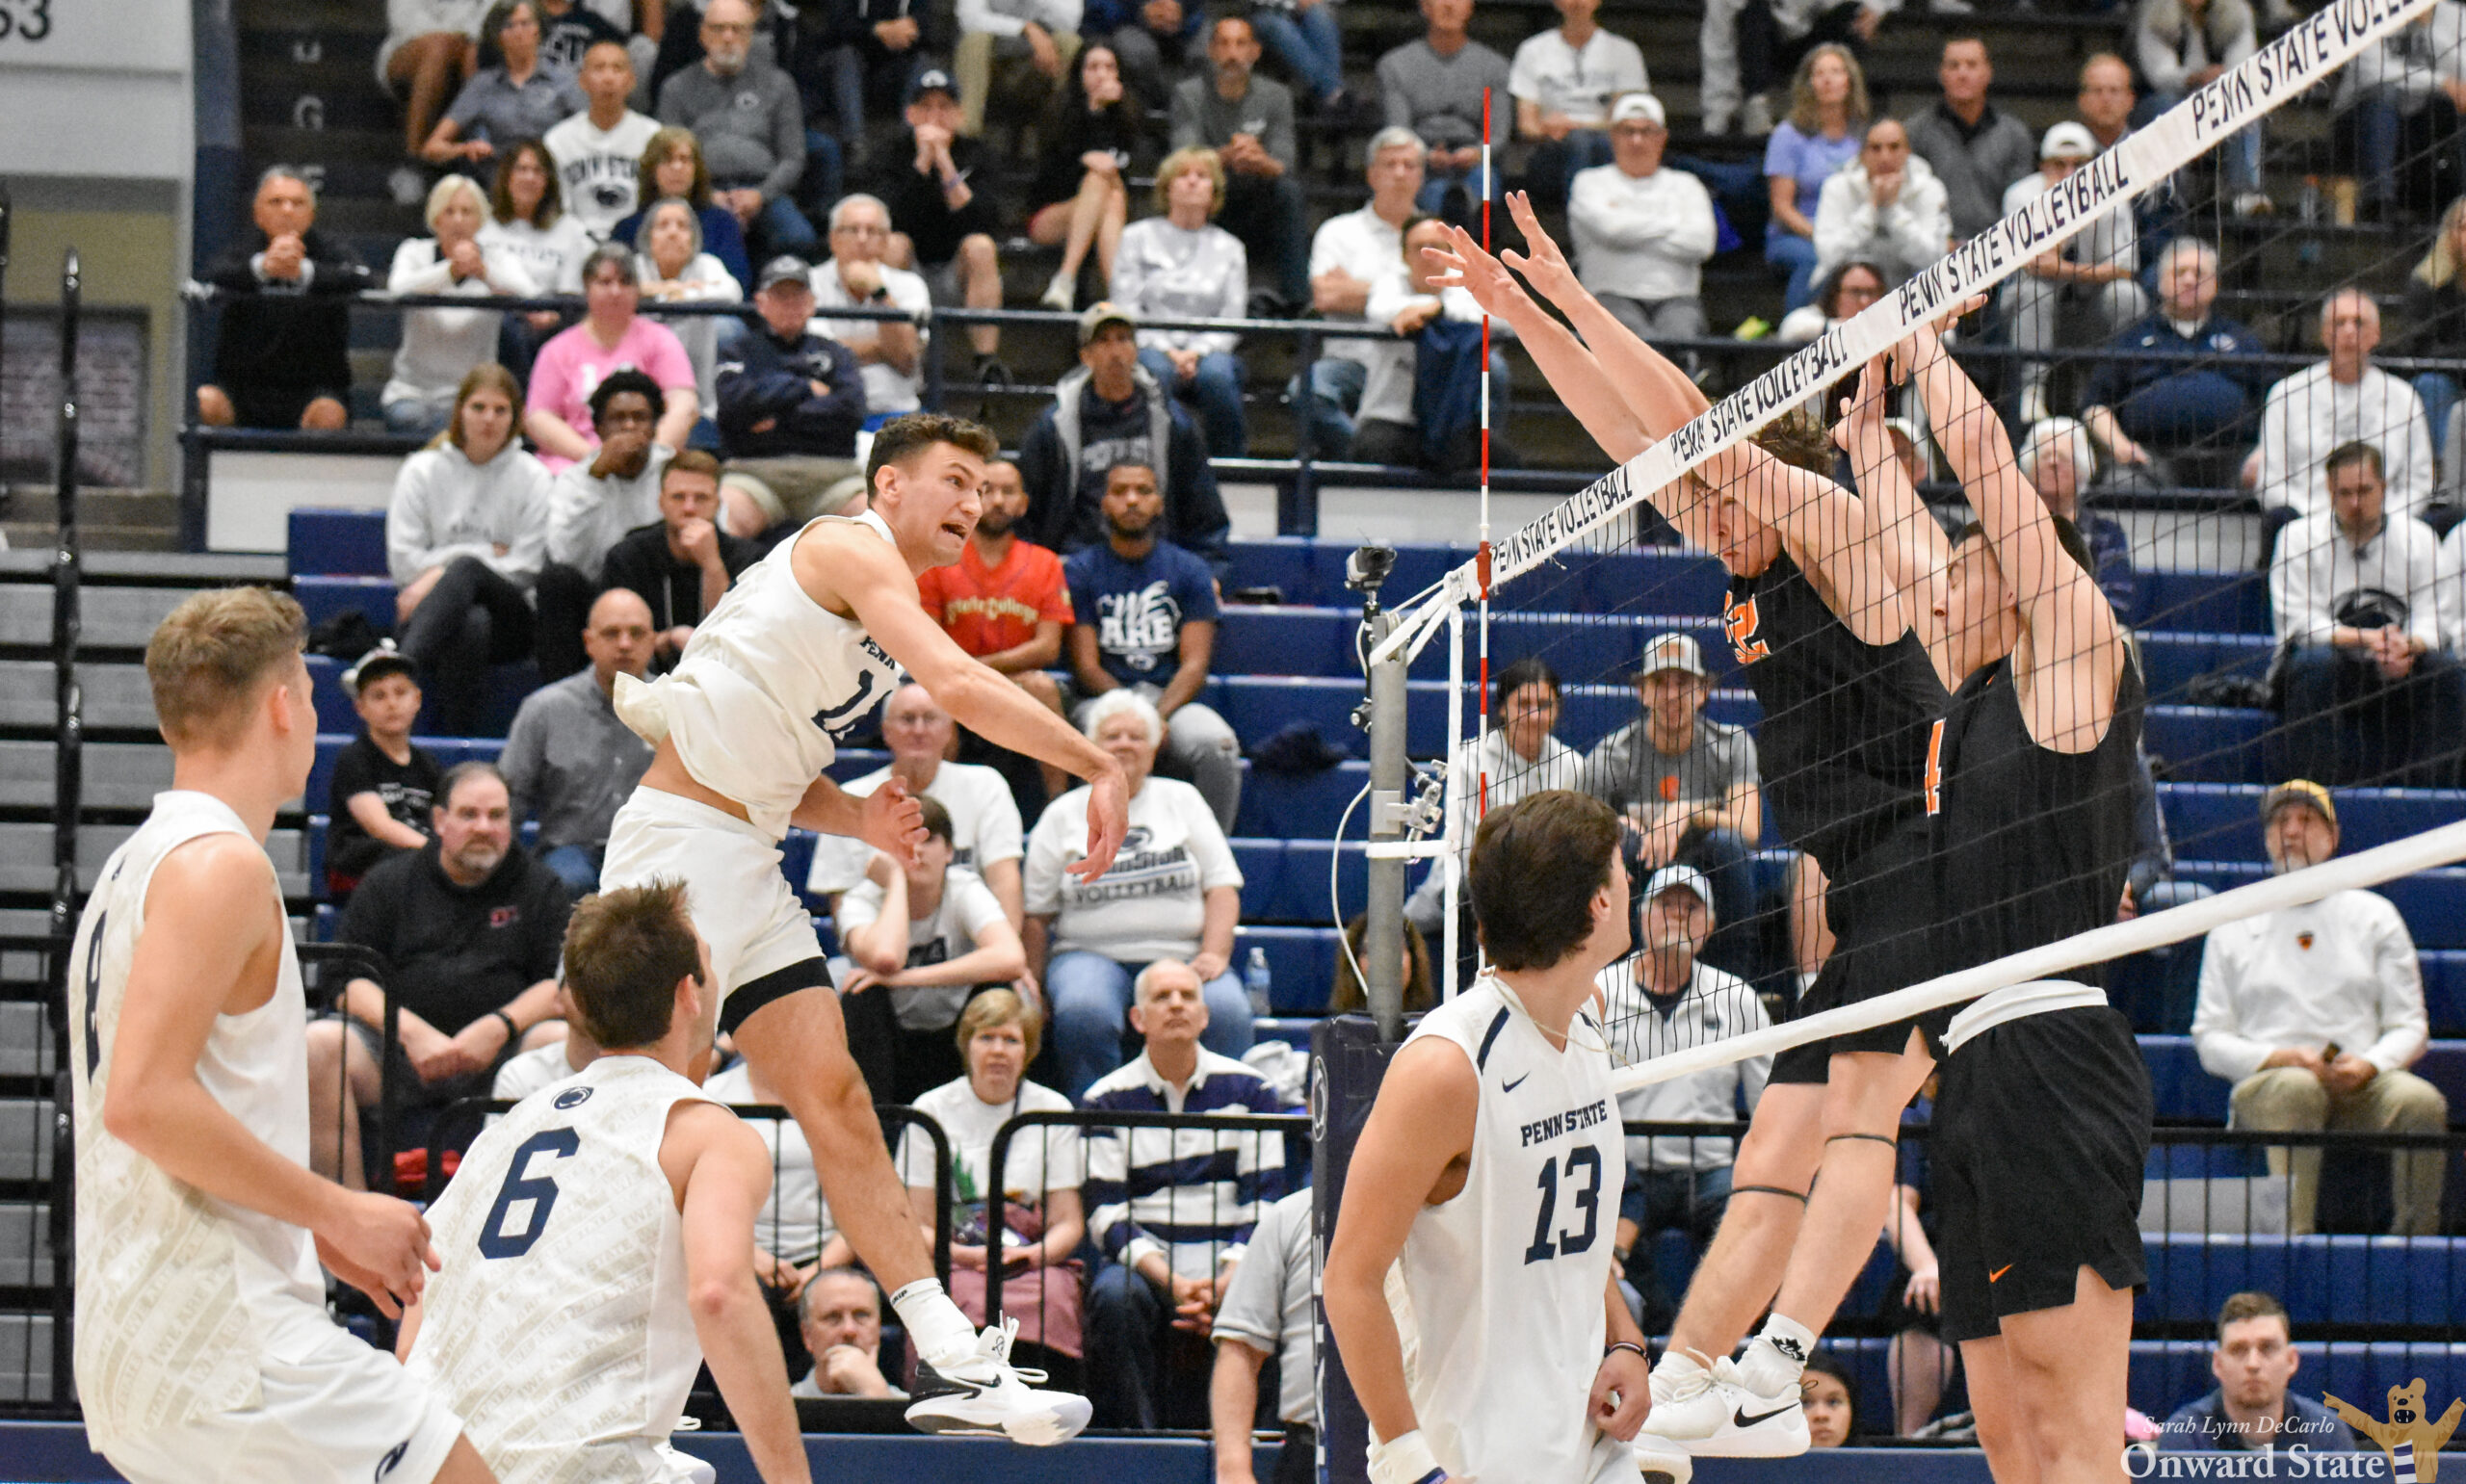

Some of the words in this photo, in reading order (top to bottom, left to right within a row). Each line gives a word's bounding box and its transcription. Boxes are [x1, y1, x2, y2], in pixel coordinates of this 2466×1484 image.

[2191, 64, 2254, 140] PENN
[2257, 13, 2329, 95] STATE
[1898, 262, 1946, 325] PENN
[1947, 225, 2004, 294] STATE
[2005, 145, 2130, 257] VOLLEYBALL
[1669, 413, 1707, 467] PENN
[1710, 384, 1754, 444] STATE
[1754, 325, 1849, 415] VOLLEYBALL
[1491, 534, 1522, 573] PENN
[1521, 513, 1558, 560] STATE
[1557, 465, 1634, 538] VOLLEYBALL
[1100, 615, 1175, 648] ARE
[1519, 1112, 1564, 1148] PENN
[1564, 1098, 1609, 1133] STATE
[477, 1126, 582, 1261] 6
[1523, 1143, 1603, 1266] 13
